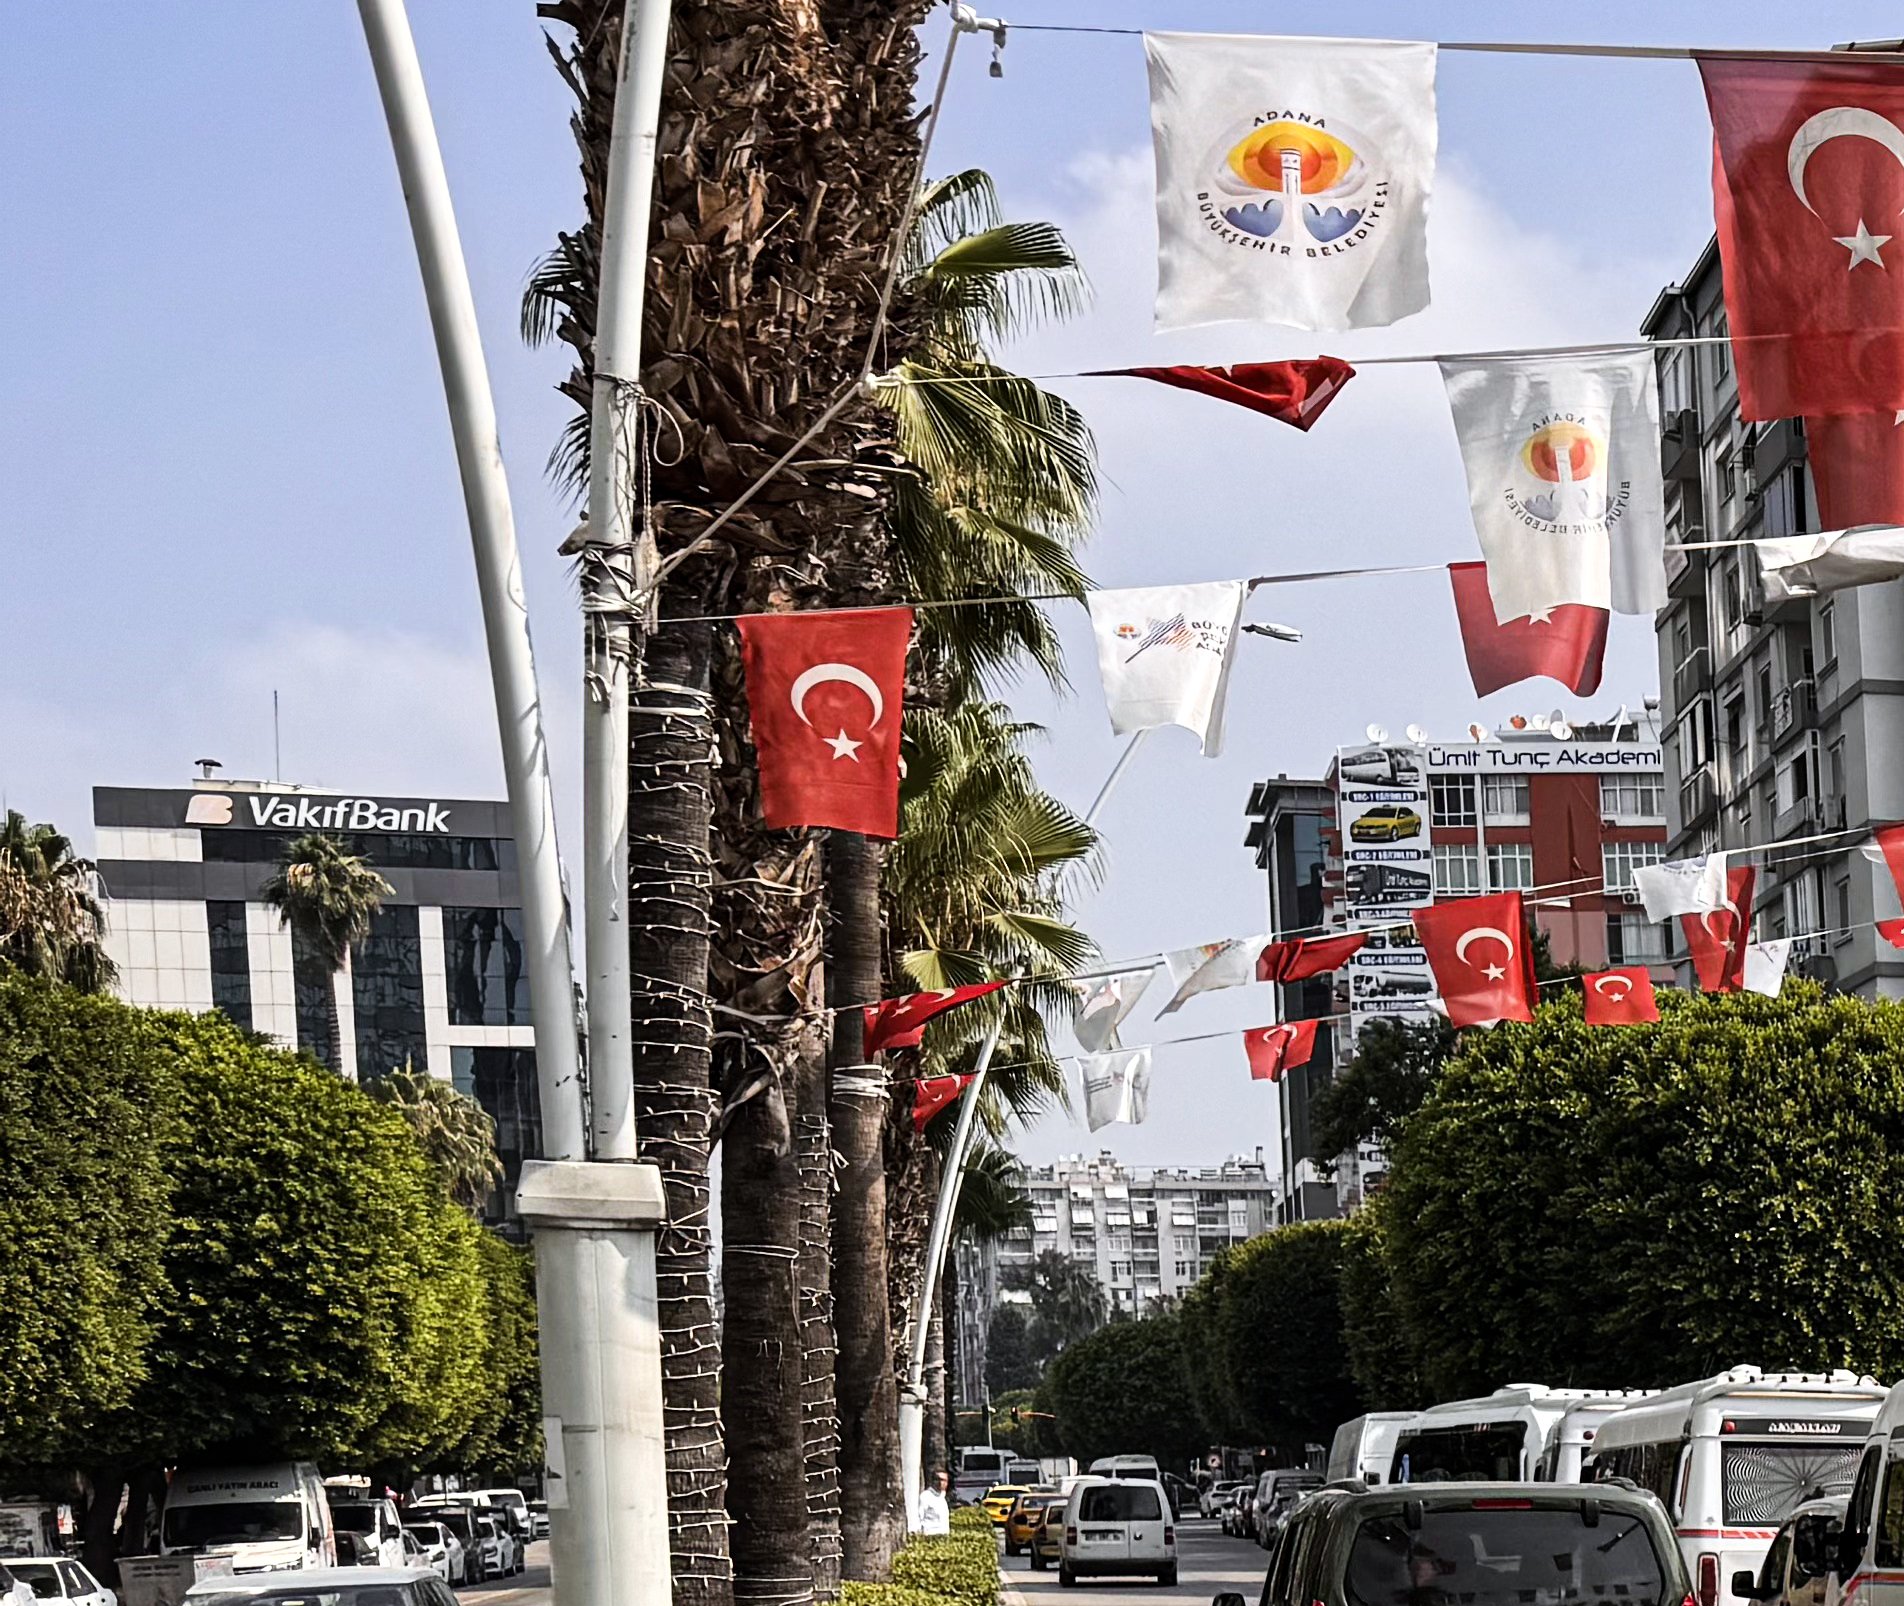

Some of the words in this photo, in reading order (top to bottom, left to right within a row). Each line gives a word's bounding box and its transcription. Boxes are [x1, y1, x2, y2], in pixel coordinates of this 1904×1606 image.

[1253, 109, 1326, 129] ADANA
[1486, 749, 1551, 769] Tunç
[249, 796, 451, 833] VakıfBank
